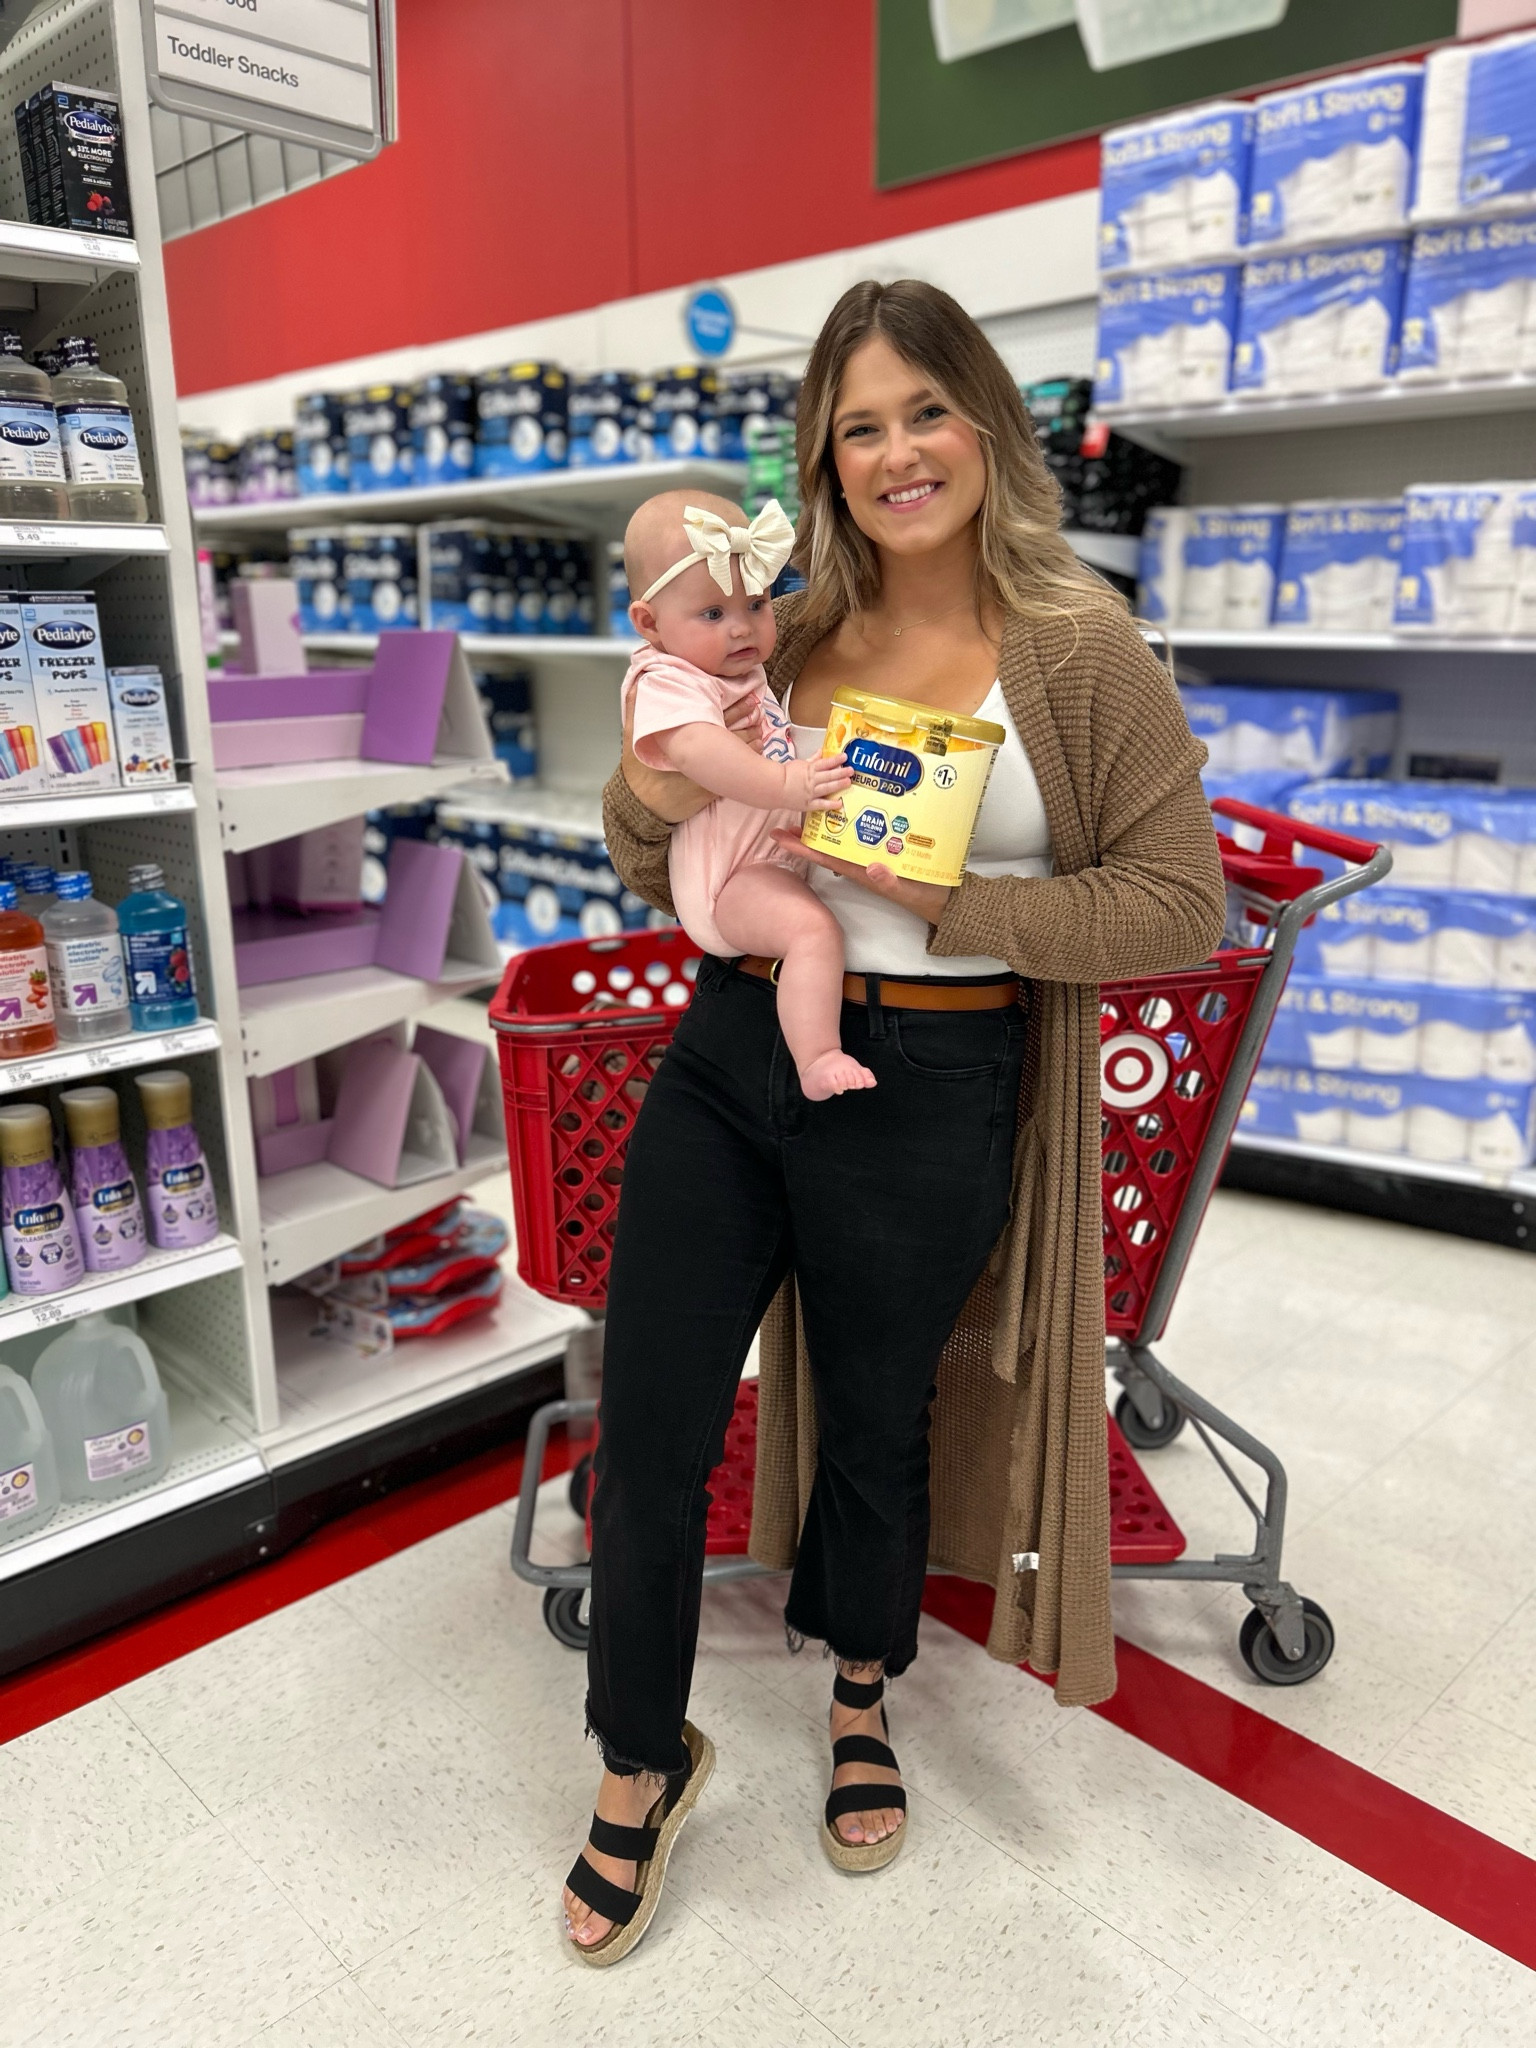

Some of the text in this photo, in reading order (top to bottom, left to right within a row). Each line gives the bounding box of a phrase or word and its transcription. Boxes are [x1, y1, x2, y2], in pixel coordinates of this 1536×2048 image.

[167, 35, 299, 88] Toddler Snacks
[1257, 83, 1406, 134] Soft & Strong
[69, 116, 113, 134] Pedialyte
[91, 147, 112, 158] MORE
[1413, 220, 1536, 259] Soft & Stro
[1306, 248, 1385, 280] Strong
[2, 426, 49, 441] Pedialyte
[83, 431, 127, 445] Pedialyte
[1348, 512, 1402, 533] Stron
[17, 533, 40, 541] 5.49
[36, 628, 94, 643] Pedialyte
[39, 656, 96, 667] FREEZER
[52, 670, 88, 680] POPS
[852, 746, 912, 778] Enfamil
[850, 774, 901, 795] NEURO PRO
[861, 814, 885, 827] BRAIN
[1289, 799, 1452, 839] Soft & Strong
[860, 821, 883, 833] BUILDING
[862, 834, 874, 842] DHA
[1345, 898, 1430, 934] Strong
[66, 940, 102, 950] pediatric
[67, 947, 109, 957] electrolyte
[0, 954, 27, 962] diatric
[0, 960, 35, 969] ectrolyte
[69, 956, 100, 964] solution
[0, 968, 25, 976] olution
[1308, 987, 1328, 1013] &
[1330, 989, 1419, 1025] Strong
[10, 1072, 32, 1083] 3.99
[1254, 1067, 1401, 1109] oft & Strong
[19, 1208, 58, 1225] Enfamil
